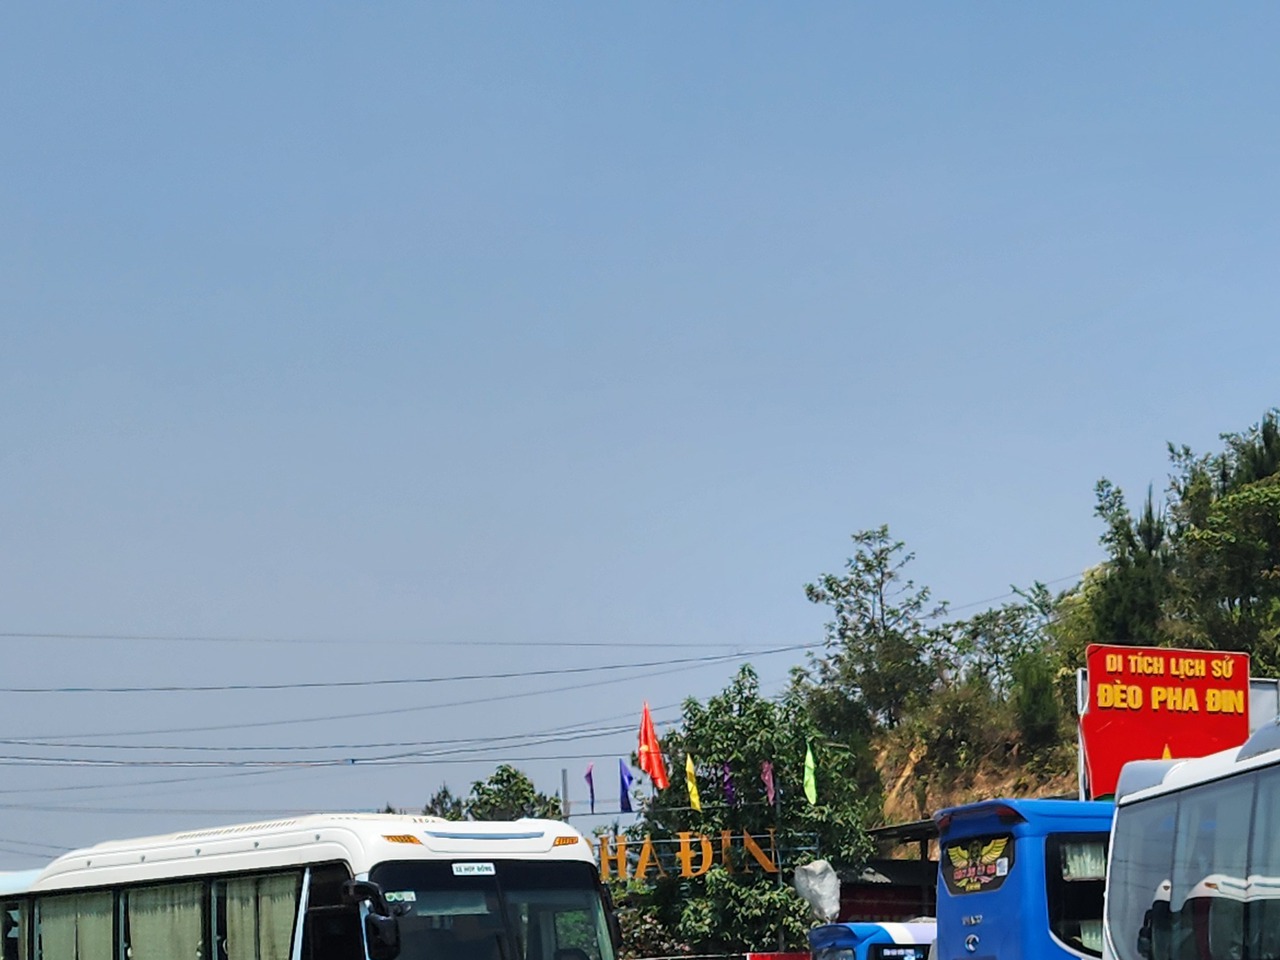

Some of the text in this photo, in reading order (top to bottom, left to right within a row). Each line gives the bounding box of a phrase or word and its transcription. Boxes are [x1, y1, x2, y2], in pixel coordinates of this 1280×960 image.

[1105, 651, 1235, 680] DI TÍCH LỊCH SỬ
[1097, 679, 1245, 714] ĐÈO PHA ĐIN
[590, 834, 669, 882] HA
